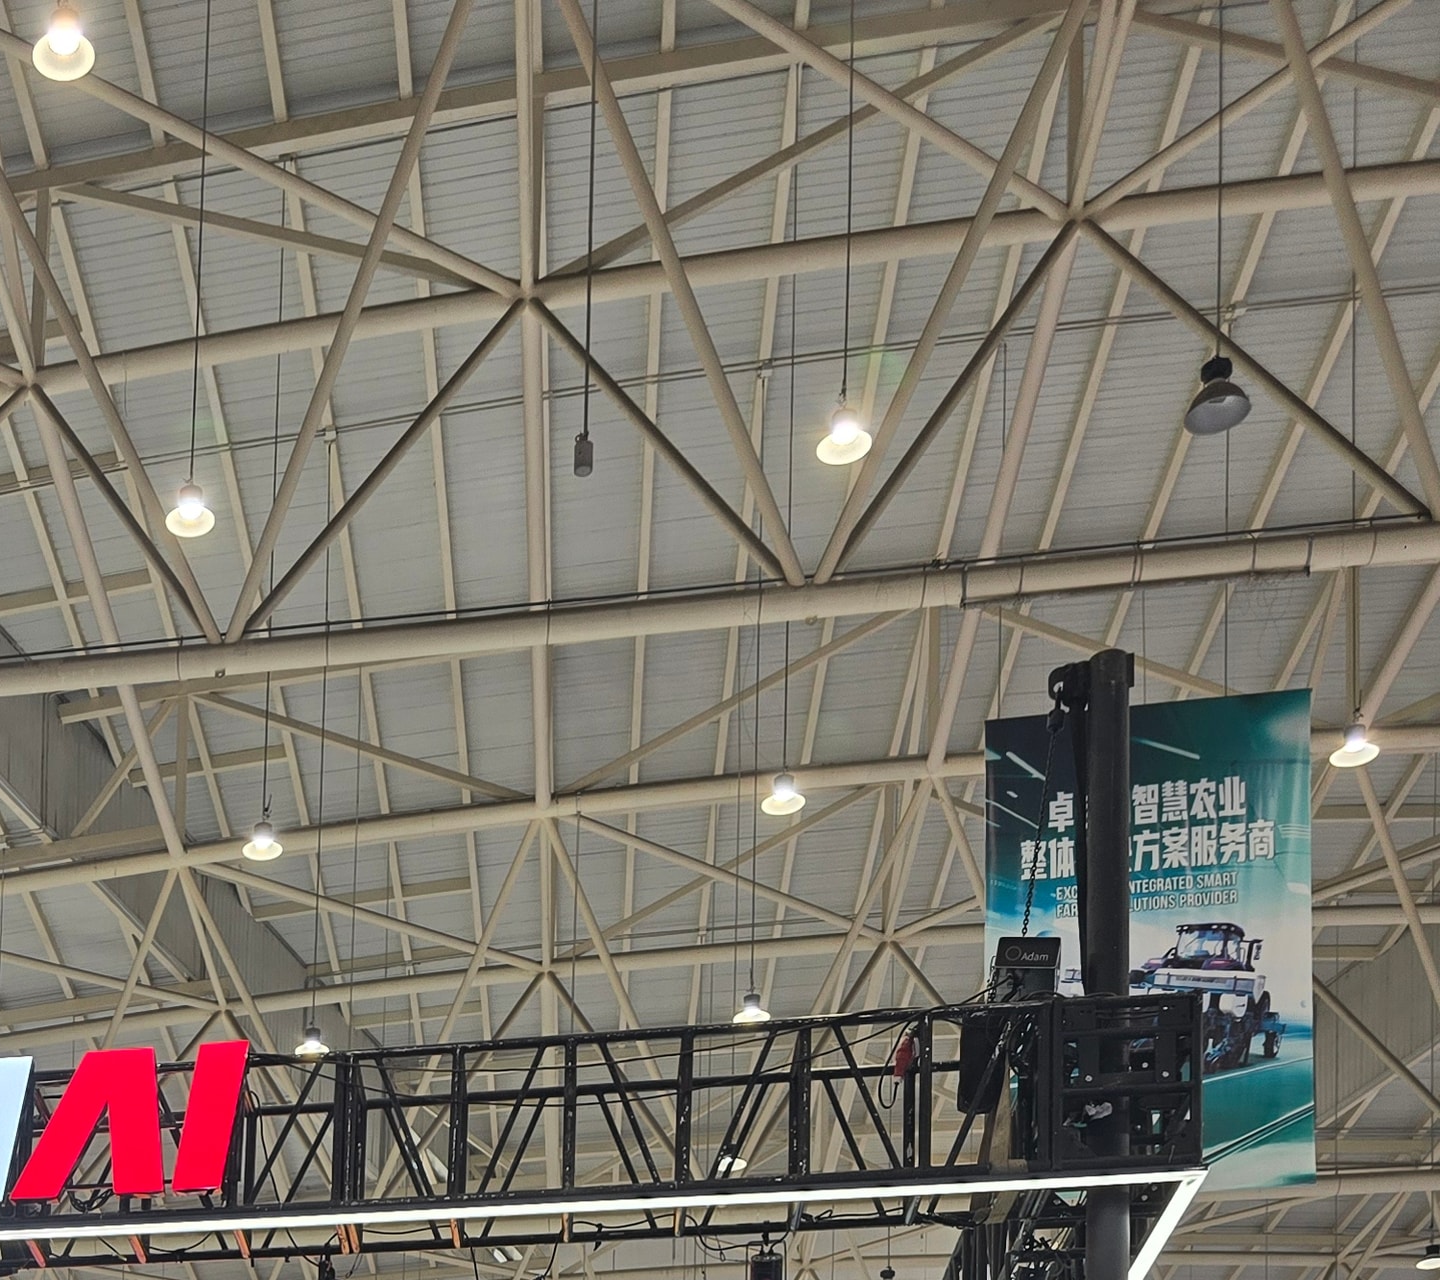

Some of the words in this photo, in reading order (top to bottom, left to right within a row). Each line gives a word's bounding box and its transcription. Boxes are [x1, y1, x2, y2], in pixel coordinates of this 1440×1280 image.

[1048, 776, 1247, 832] 卓智慧农业
[1020, 819, 1275, 880] 整体方案服务商
[1196, 871, 1238, 889] SMART
[1179, 889, 1238, 908] PROVIDER
[1020, 951, 1049, 962] Adam
